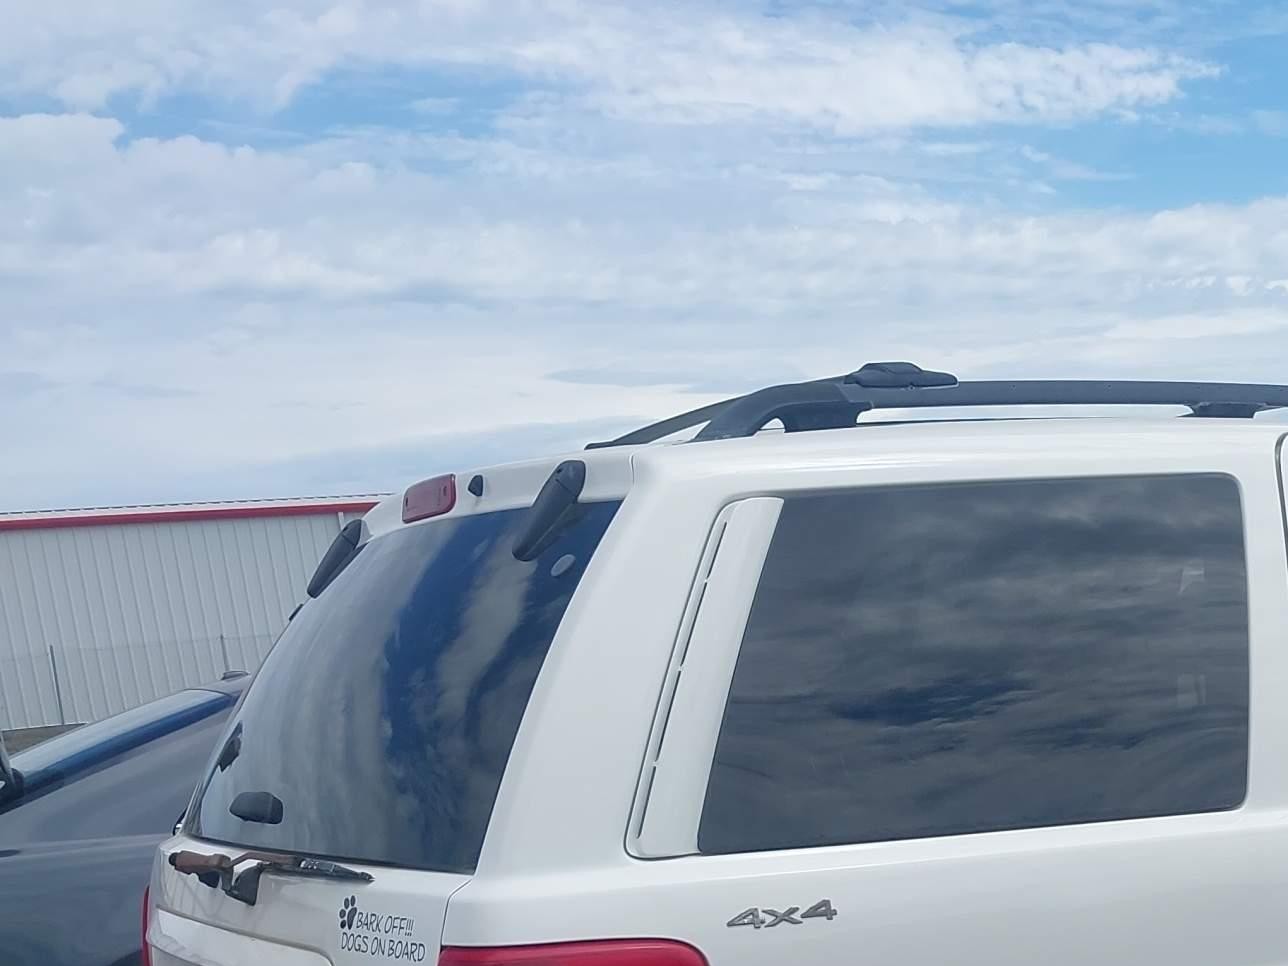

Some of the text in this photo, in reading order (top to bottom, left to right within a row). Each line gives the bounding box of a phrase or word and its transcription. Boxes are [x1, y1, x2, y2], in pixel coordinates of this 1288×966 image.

[356, 911, 414, 937] BARK OFF!!!
[341, 932, 426, 962] DOGS ON BOARD
